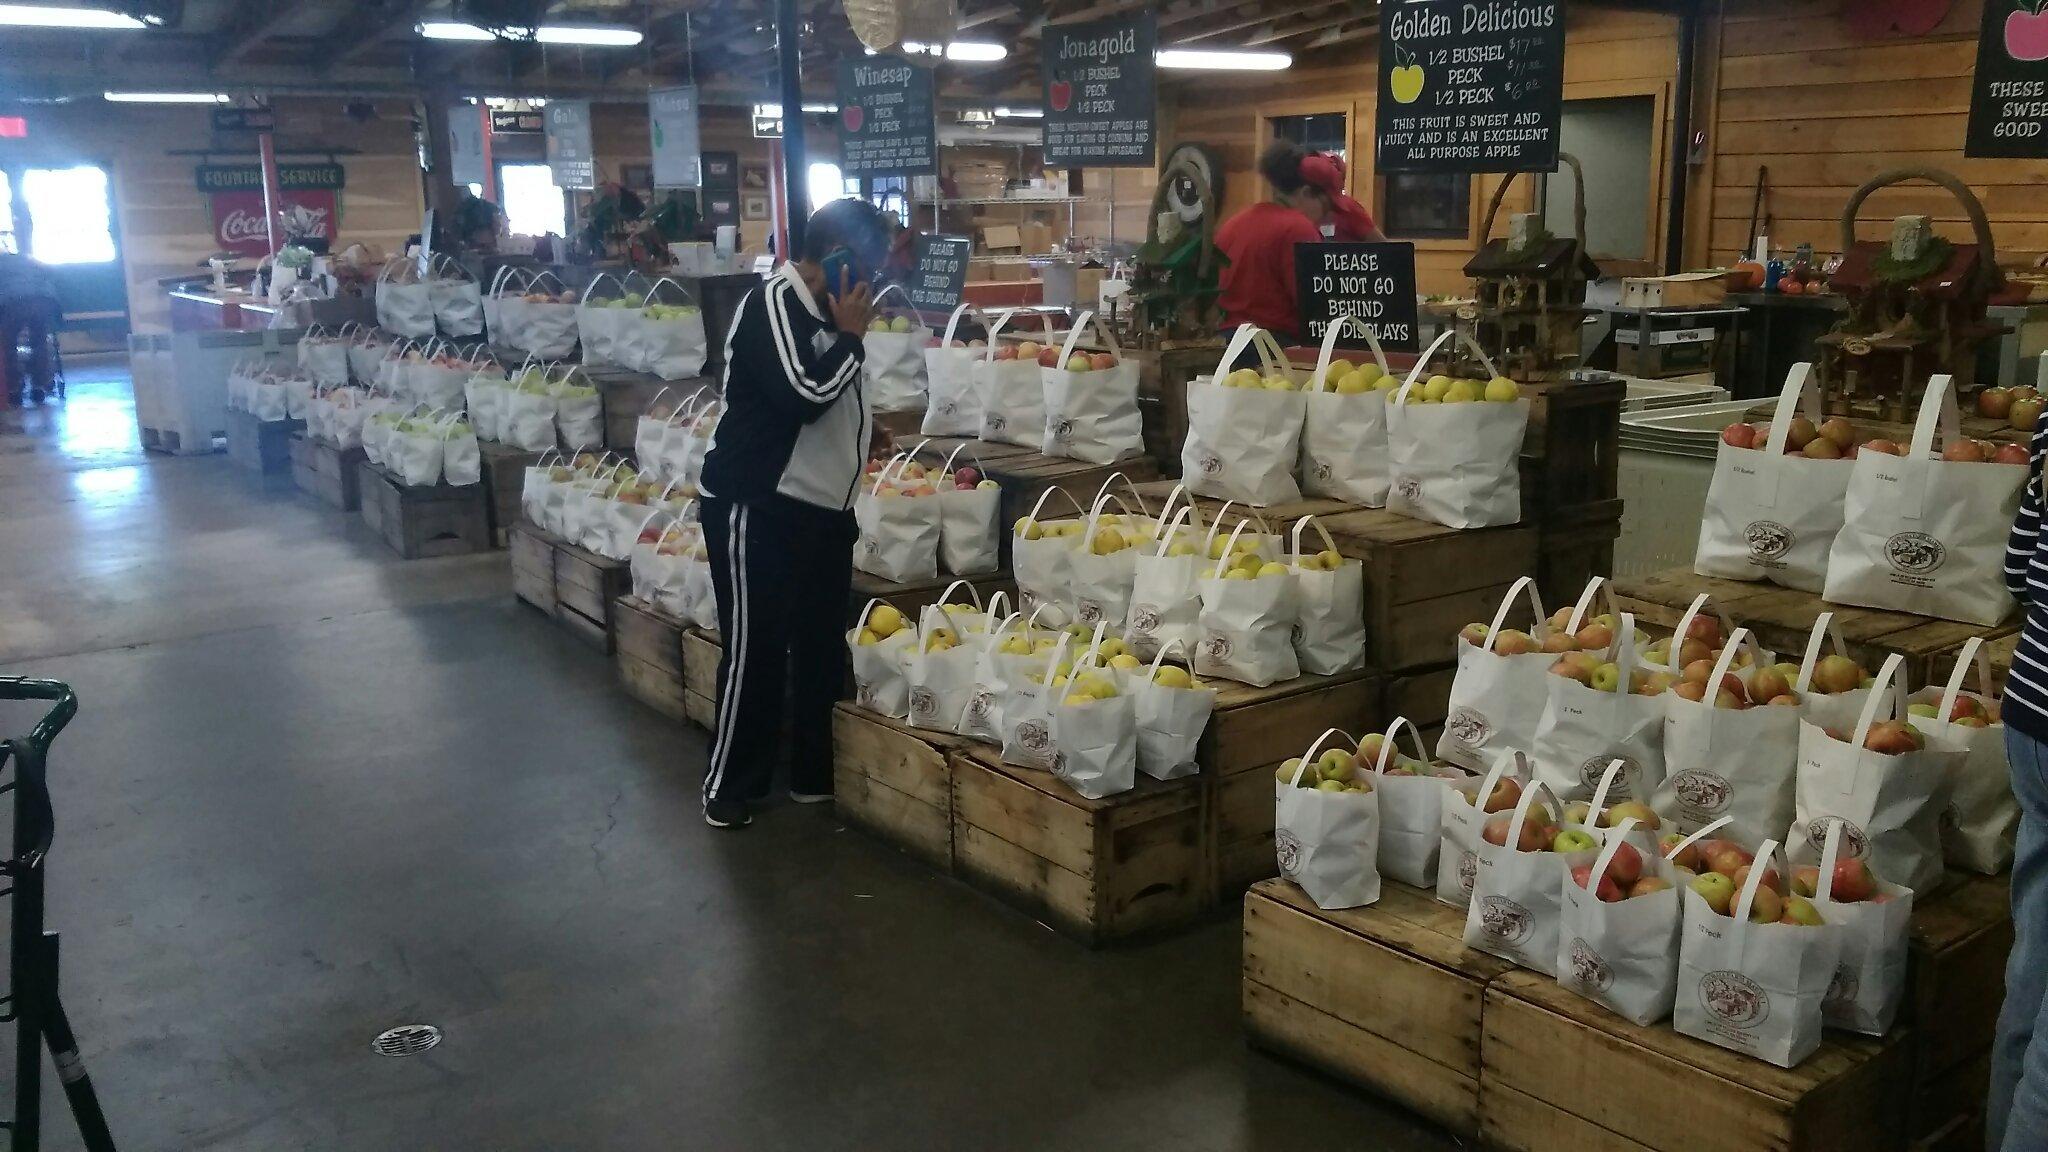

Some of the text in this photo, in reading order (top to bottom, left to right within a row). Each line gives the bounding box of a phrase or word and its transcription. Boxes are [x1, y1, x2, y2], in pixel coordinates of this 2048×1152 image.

[1390, 1, 1556, 41] Golden Delicious
[1059, 28, 1136, 64] Jonagold
[1429, 45, 1505, 66] 1/2 BUSHEL
[854, 66, 912, 88] Winesap
[1087, 66, 1120, 80] BUSHEL
[1448, 67, 1484, 85] PECK
[1085, 84, 1108, 97] PECK
[1435, 87, 1495, 106] 1/2 PECK
[1990, 81, 2044, 98] THESE
[874, 106, 894, 119] PECK
[1092, 100, 1116, 113] PECK
[881, 120, 901, 133] PECK
[1135, 119, 1149, 130] ARE
[1393, 112, 1541, 130] THIS FRUIT IS SWEET AND
[1135, 132, 1149, 143] AND
[1385, 127, 1549, 146] JUICY AND IS AN EXCELLENT
[1993, 122, 2042, 138] GOOD
[1407, 145, 1521, 160] ALL PURPOSE APPLE
[280, 169, 336, 185] SERVICE
[929, 243, 955, 256] PLEASE
[920, 258, 958, 273] DO NOT GO
[1324, 253, 1379, 272] PLEASE
[1312, 276, 1394, 295] DO NOT GO
[1327, 299, 1384, 318] BEHIND
